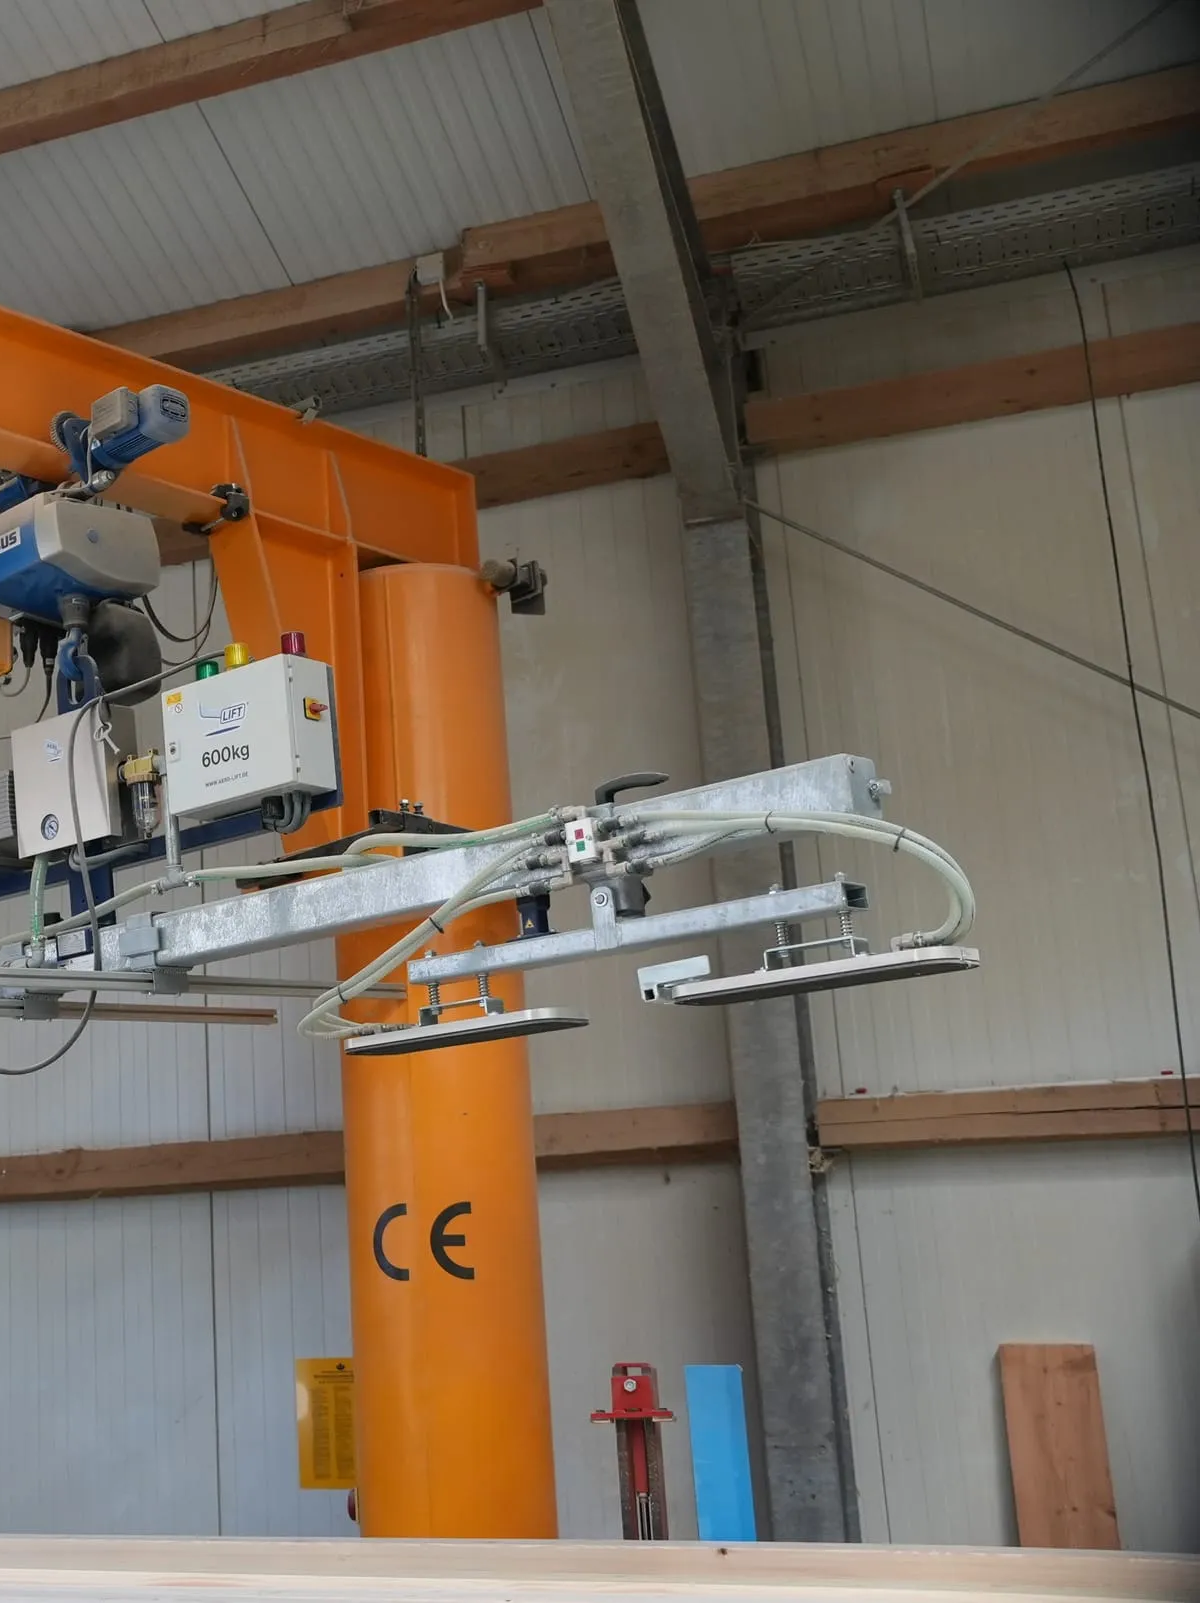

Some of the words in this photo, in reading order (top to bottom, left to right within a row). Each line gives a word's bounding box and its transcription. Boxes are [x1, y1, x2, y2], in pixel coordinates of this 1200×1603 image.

[222, 706, 244, 722] LIFT
[202, 744, 250, 768] 600kg
[373, 1201, 475, 1281] CE
